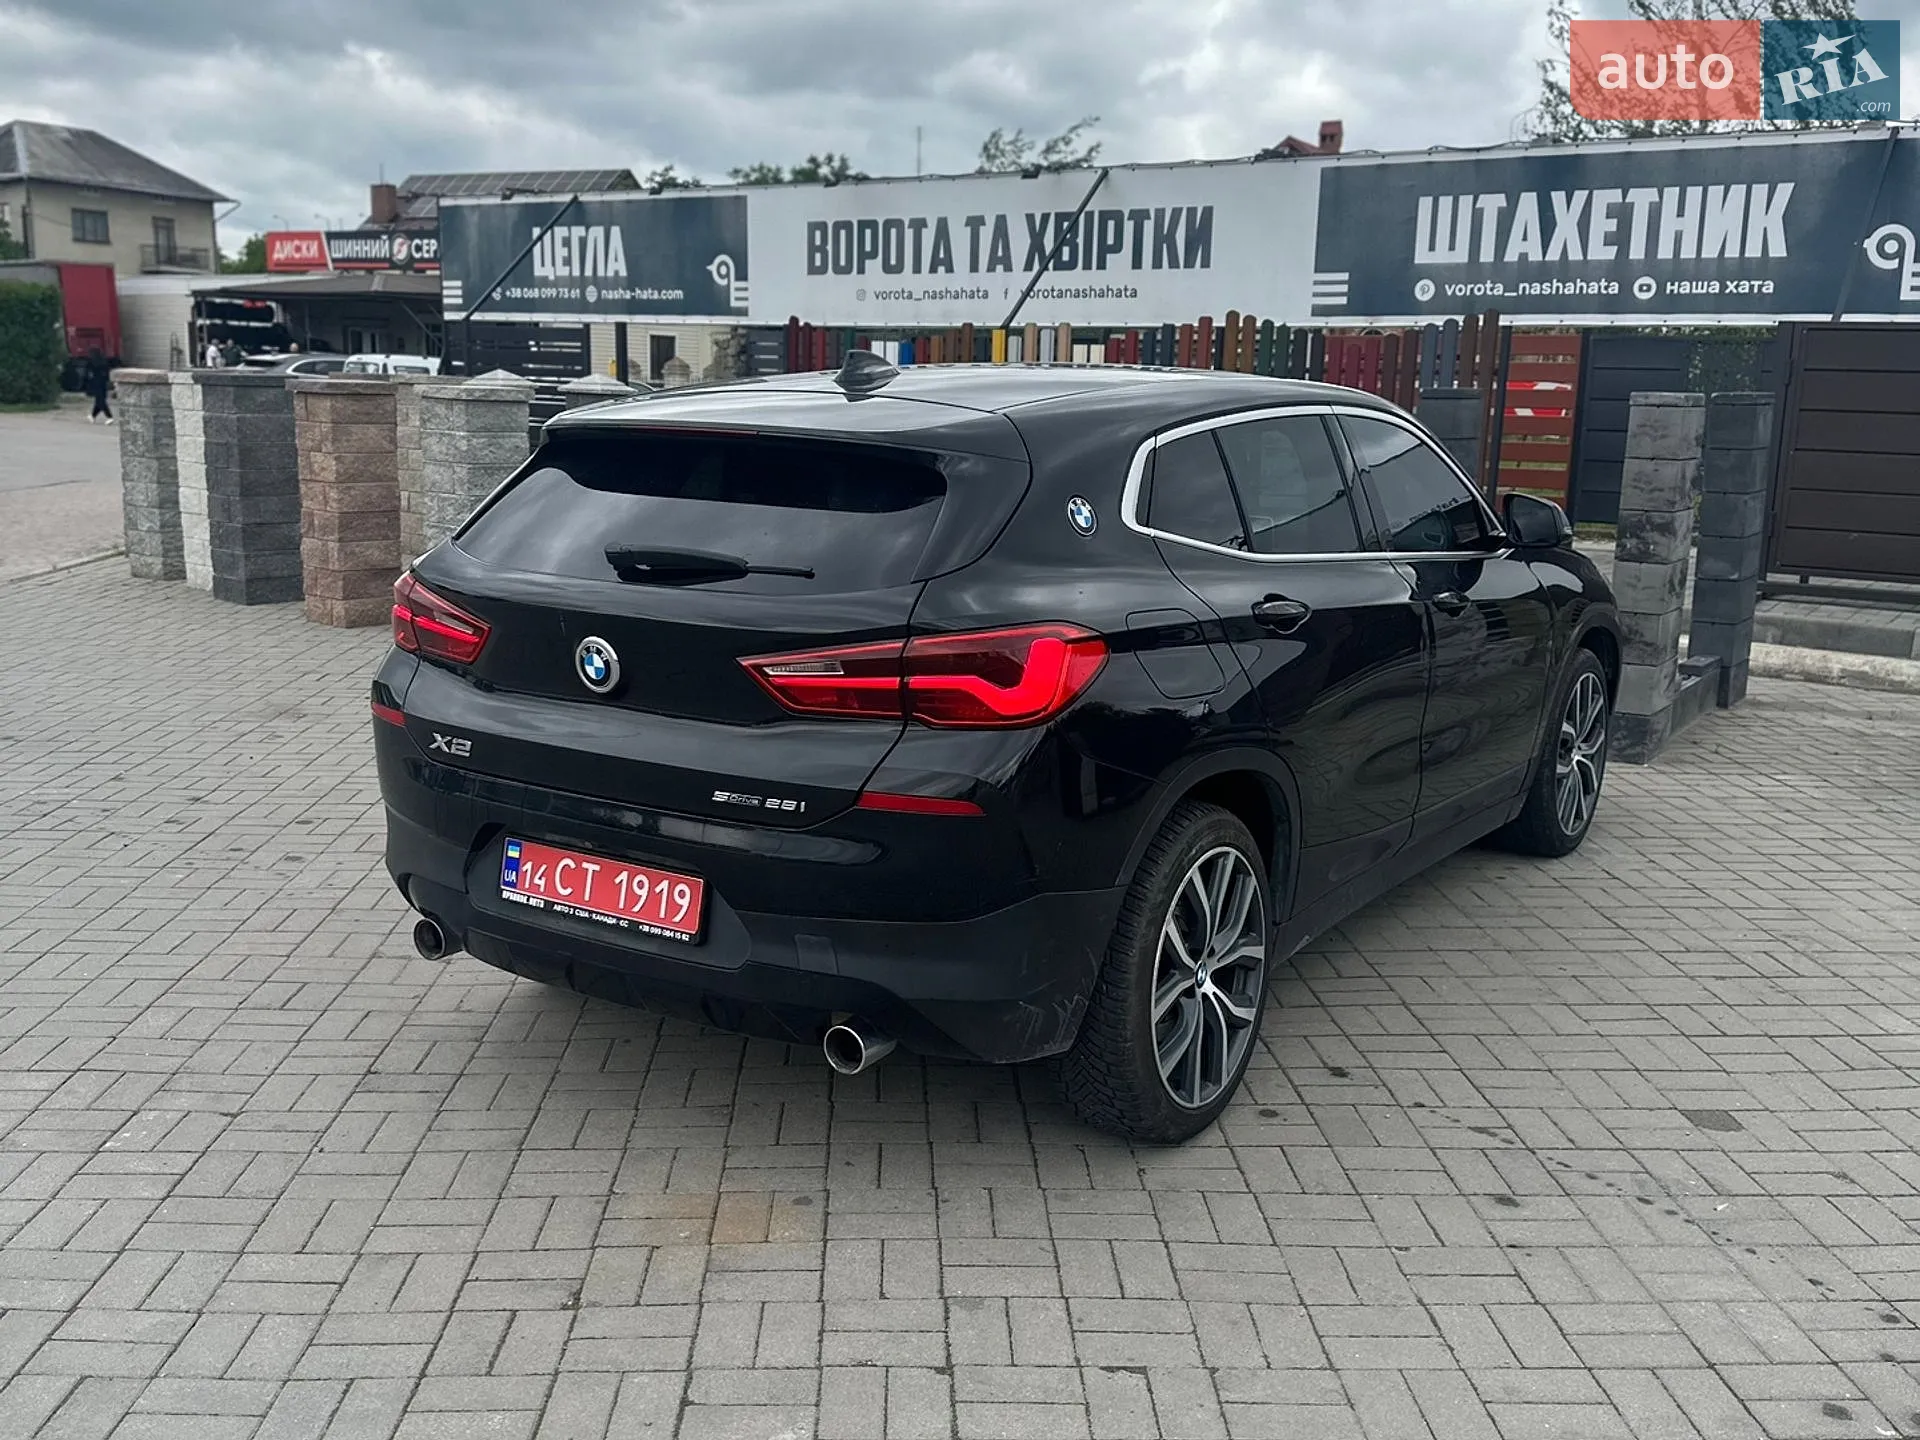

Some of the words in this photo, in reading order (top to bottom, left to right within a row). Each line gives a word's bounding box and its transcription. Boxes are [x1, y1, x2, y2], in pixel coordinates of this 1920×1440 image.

[1413, 182, 1796, 265] ШТАХЕТНИК
[273, 239, 319, 260] ДИСКИ
[330, 234, 390, 258] ШИННИЙ
[806, 216, 955, 276] ВОРОТА
[964, 213, 1014, 274] ТА
[1023, 205, 1214, 272] ХВІРТКИ
[532, 225, 627, 280] ЦЕГЛА
[506, 288, 522, 298] +38
[558, 287, 568, 298] 73
[601, 287, 684, 300] nasha-hata.com
[874, 286, 989, 301] vorota_nashahata
[1445, 278, 1620, 297] vorota_nashahata
[1666, 280, 1720, 294] наша
[1724, 280, 1774, 294] хата
[428, 732, 473, 758] X2
[503, 869, 517, 884] UA
[522, 860, 548, 893] 14
[554, 857, 601, 902] CT
[614, 870, 692, 923] 1919
